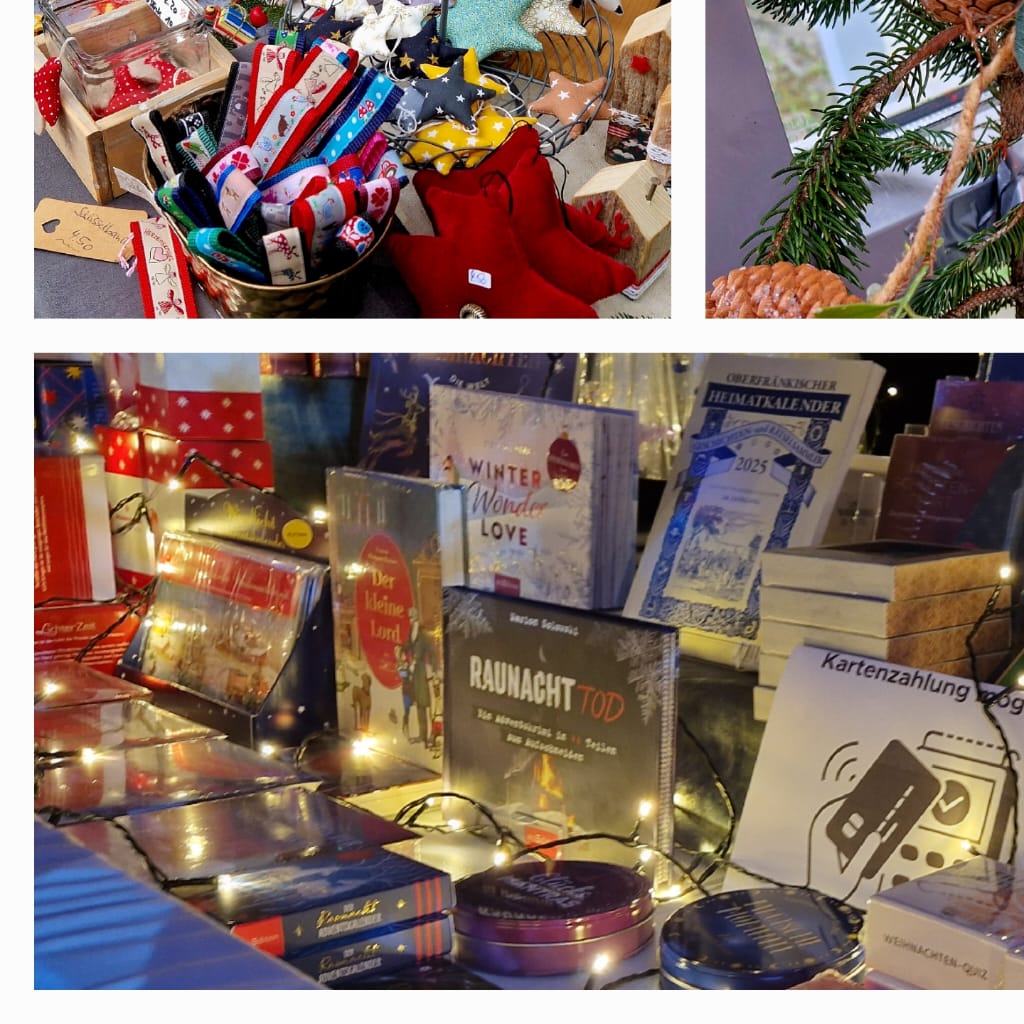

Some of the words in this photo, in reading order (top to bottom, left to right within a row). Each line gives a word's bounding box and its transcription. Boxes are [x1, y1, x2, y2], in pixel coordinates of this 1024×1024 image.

[726, 373, 838, 392] OBERFRÄNKISCHER
[707, 389, 843, 415] HEIMATKALENDER
[469, 457, 542, 490] WINTER
[735, 455, 769, 475] 2025
[468, 480, 549, 518] Wonder
[481, 521, 528, 547] LOVE
[371, 568, 396, 590] Der
[364, 590, 405, 618] kleine
[370, 619, 402, 645] Lord
[469, 654, 577, 712] RAUNACHT
[576, 683, 626, 723] TOD
[820, 651, 971, 704] Kartenzahlung
